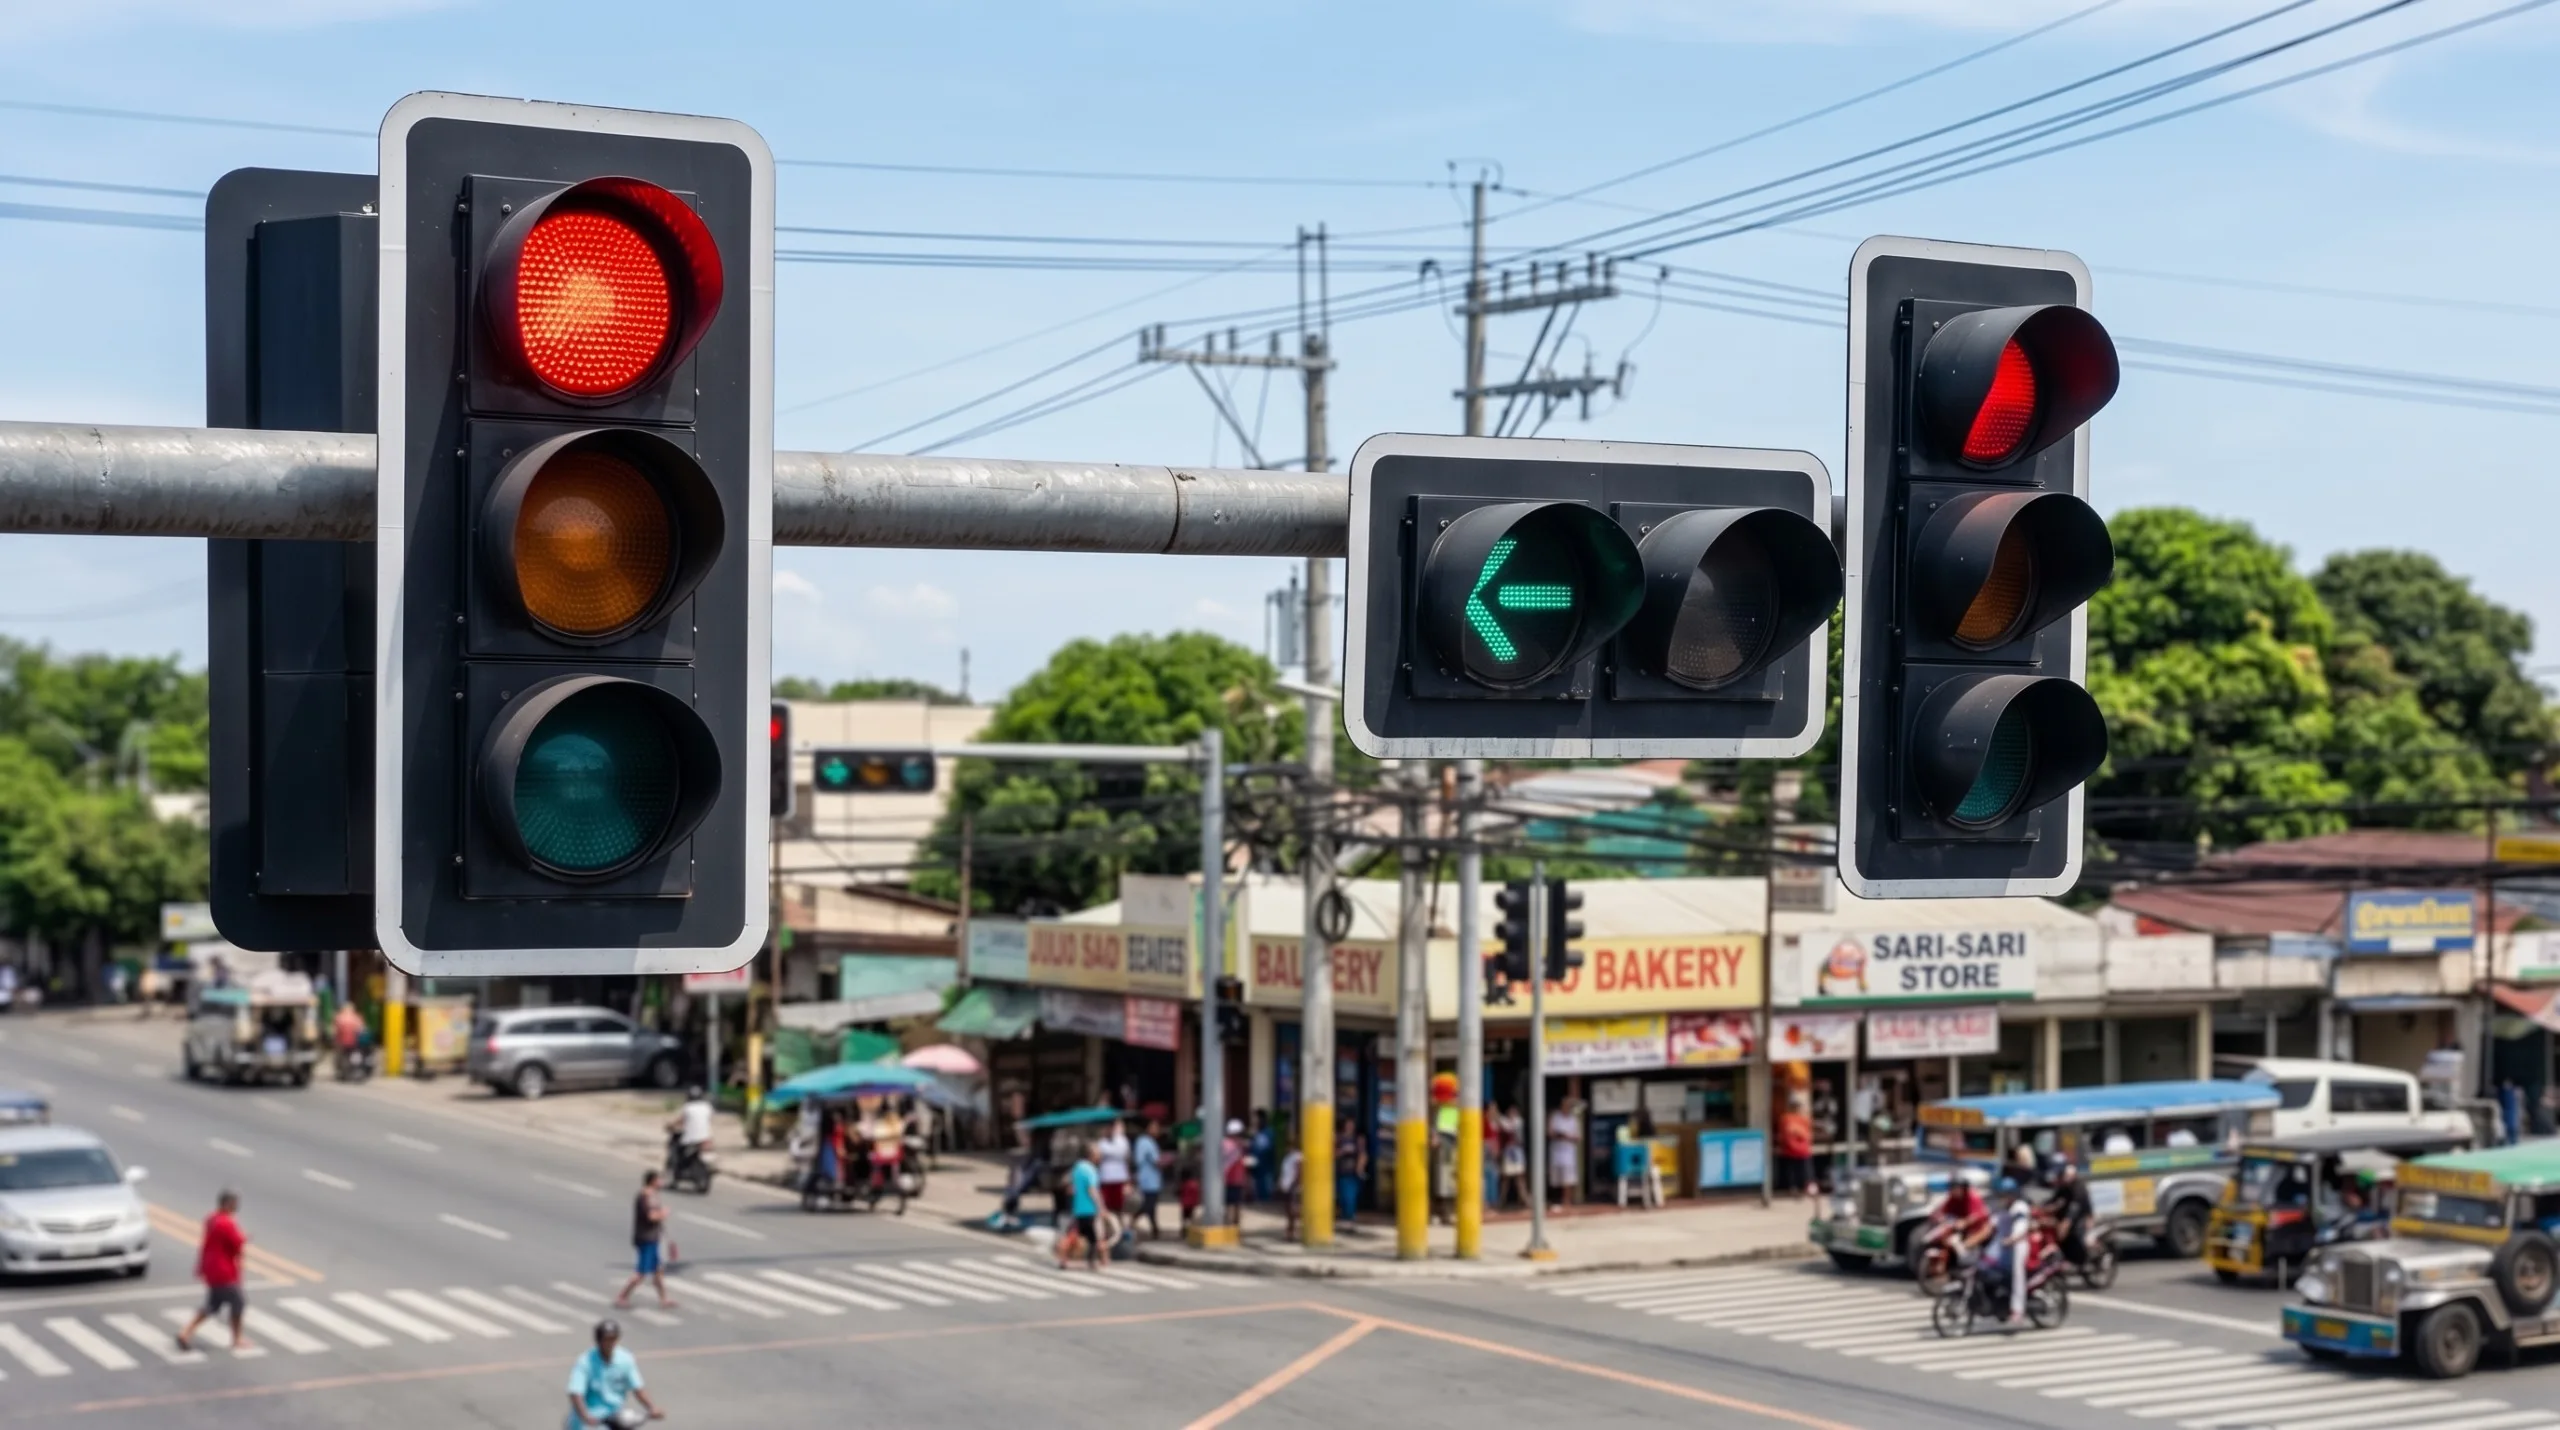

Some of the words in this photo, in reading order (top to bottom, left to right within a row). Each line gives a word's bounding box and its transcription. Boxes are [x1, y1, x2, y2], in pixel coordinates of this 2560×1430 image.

[1873, 932, 2026, 961] SARI-SARI
[1594, 945, 1745, 992] BAKERY
[1900, 962, 2000, 990] STORE
